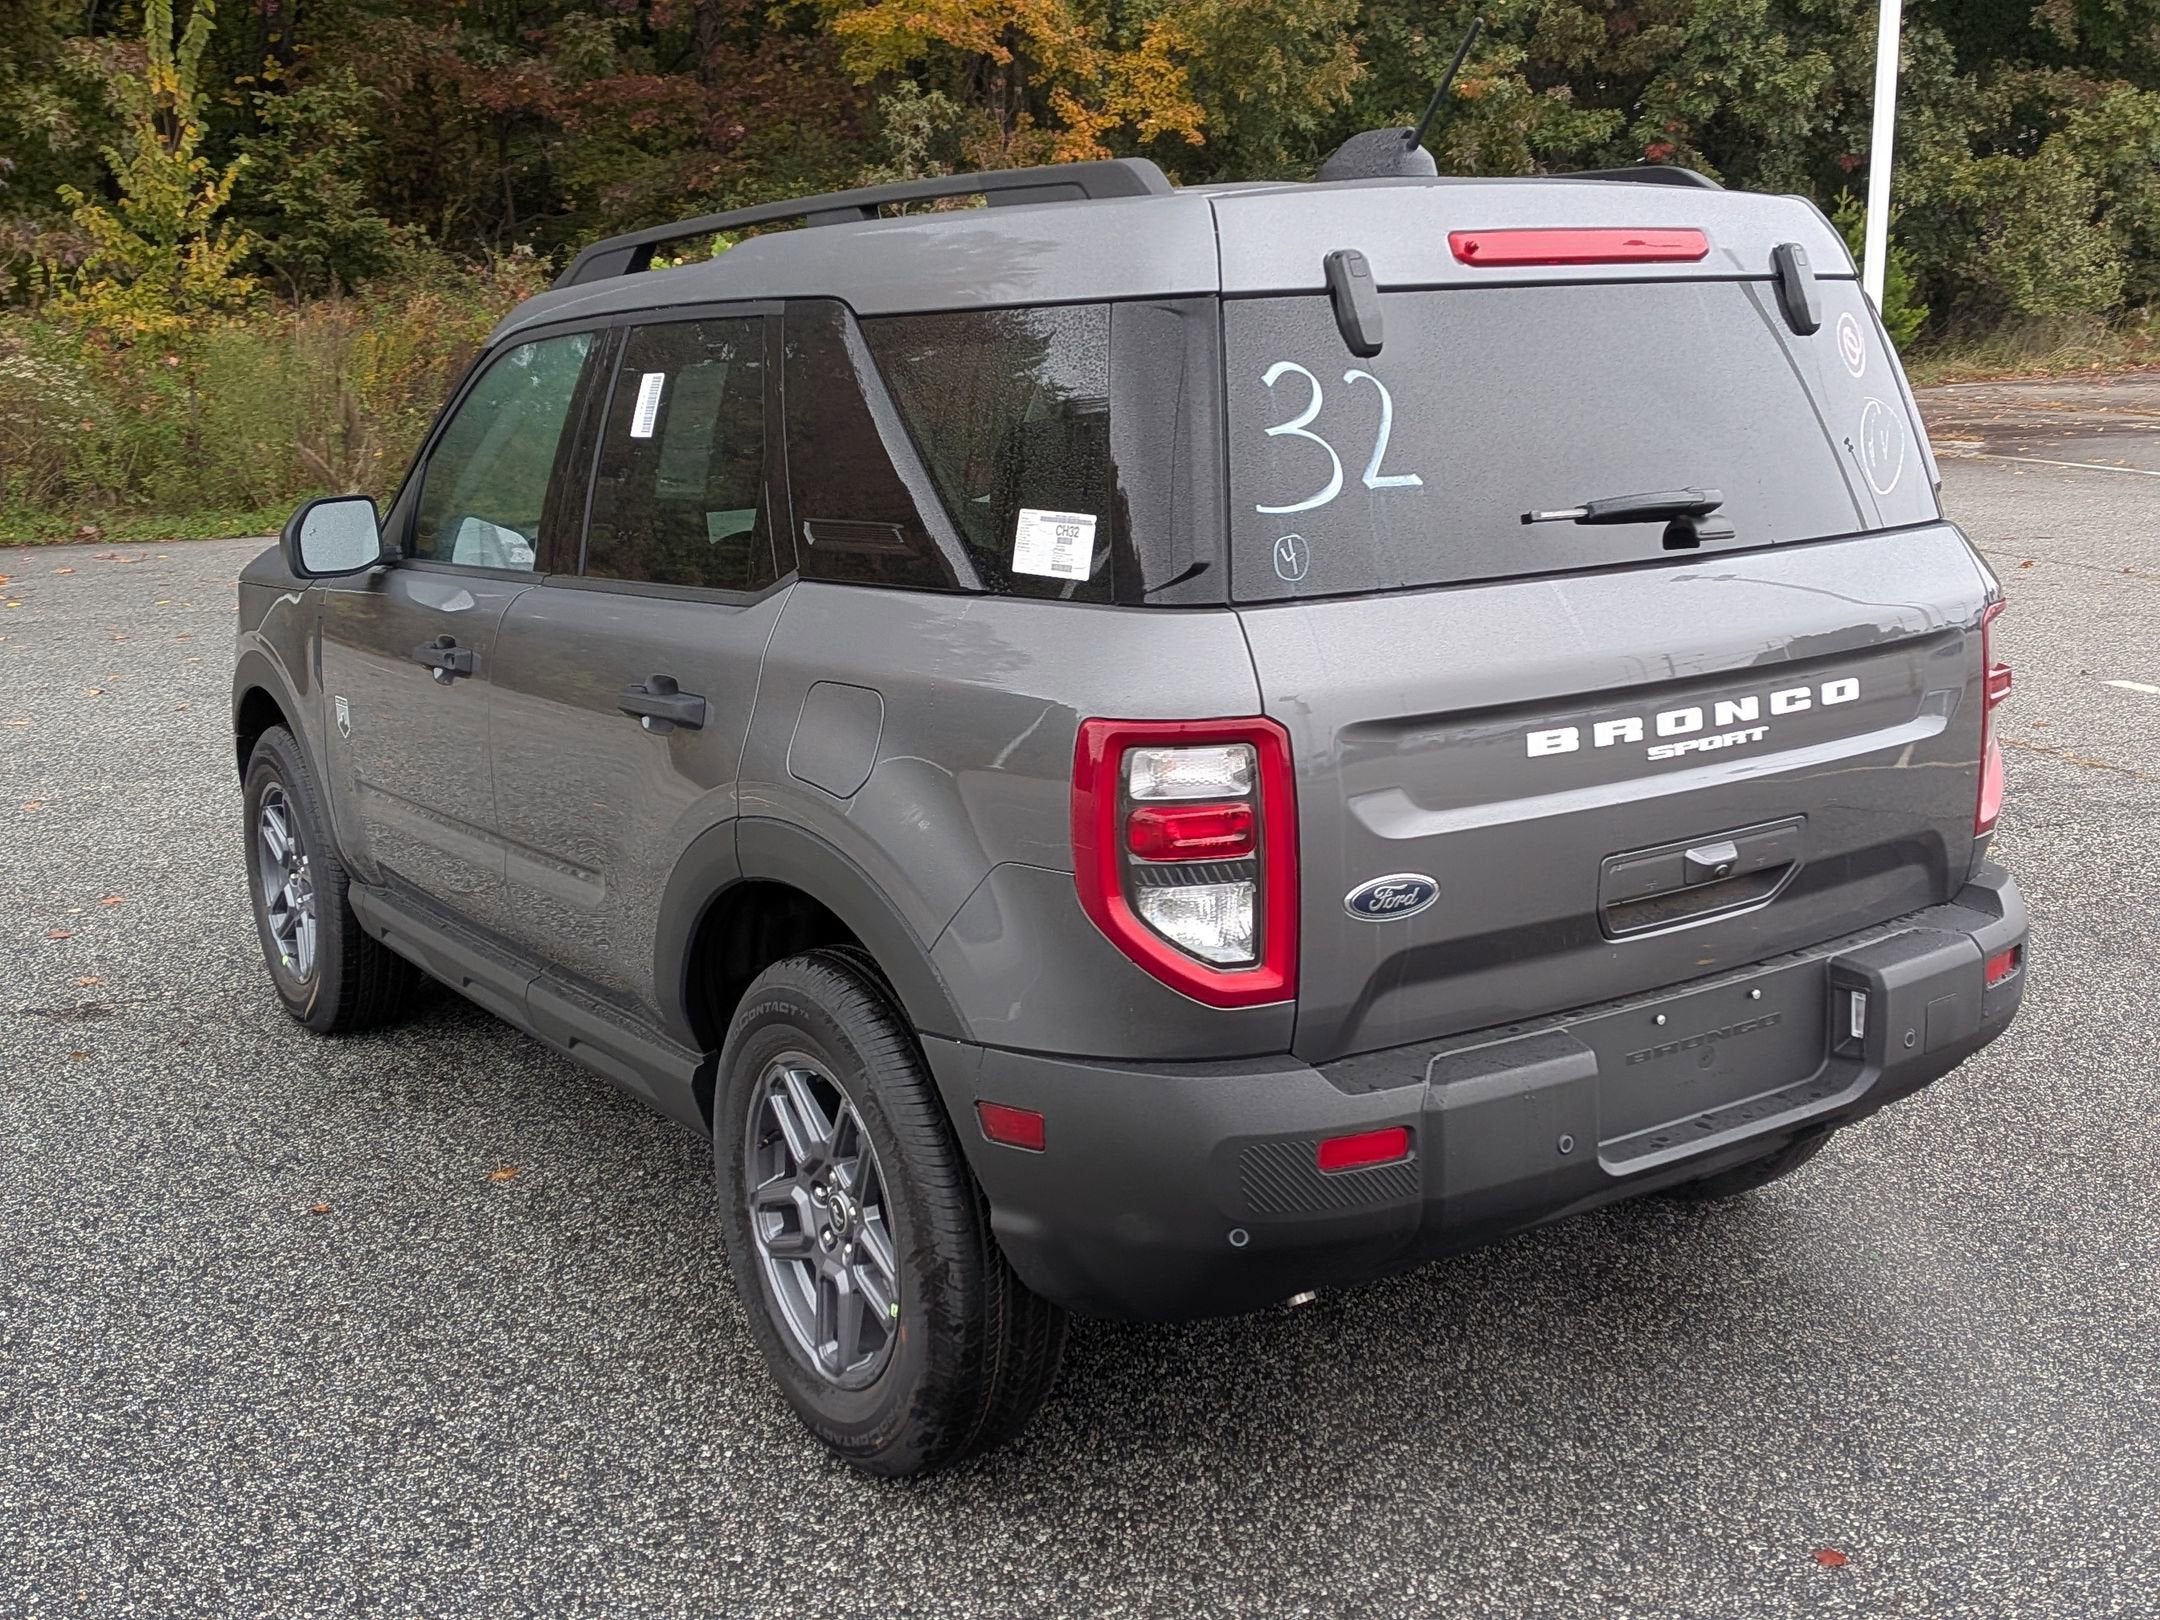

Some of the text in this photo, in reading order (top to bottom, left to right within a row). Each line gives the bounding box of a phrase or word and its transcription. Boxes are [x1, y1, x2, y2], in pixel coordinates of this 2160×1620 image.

[1256, 361, 1423, 513] 32
[1055, 524, 1080, 538] CH32
[1280, 539, 1298, 575] 4
[1526, 677, 1860, 757] BRONCO
[1647, 726, 1769, 760] SPORT
[1369, 884, 1420, 911] Ford
[1626, 1012, 1782, 1066] BRONCO
